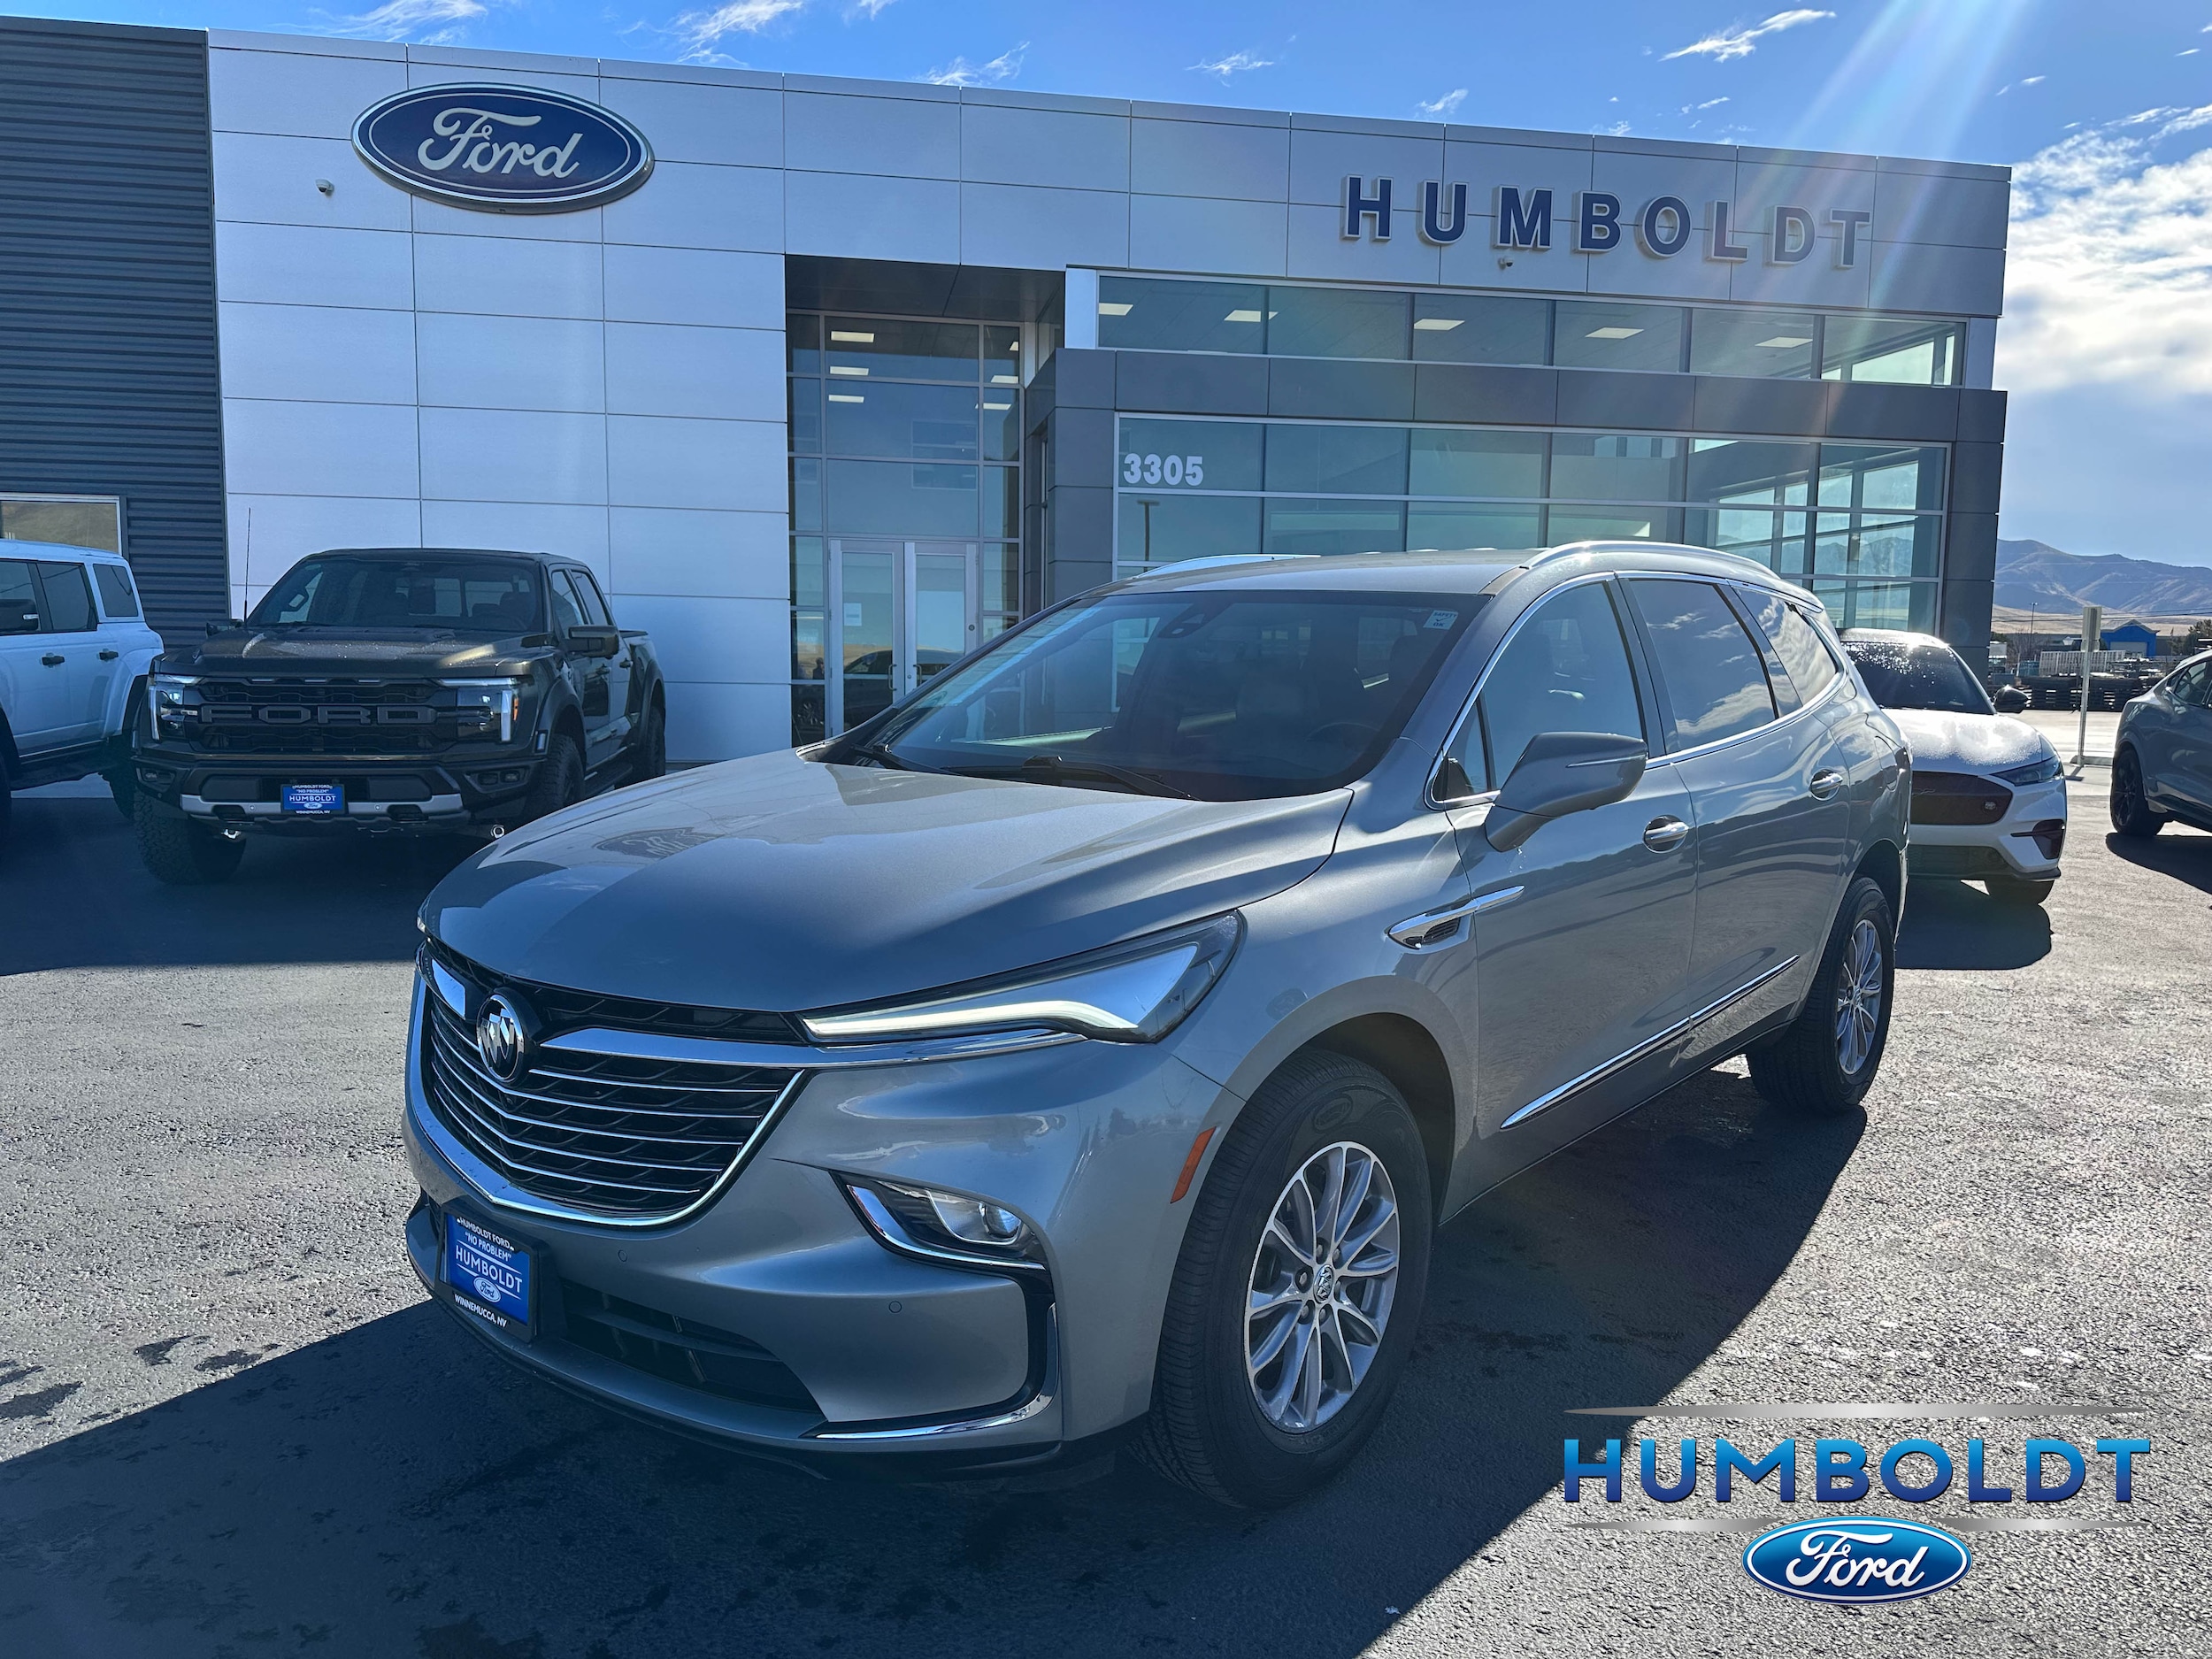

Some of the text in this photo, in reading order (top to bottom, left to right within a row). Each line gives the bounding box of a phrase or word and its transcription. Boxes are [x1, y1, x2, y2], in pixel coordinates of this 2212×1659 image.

[418, 107, 583, 179] Ford
[1341, 173, 1872, 269] HUMBOLDT
[1123, 452, 1204, 487] 3305
[201, 704, 438, 725] FORD
[459, 1217, 511, 1250] HUMBOLDT FORD
[465, 1232, 512, 1263] "NO PROBLEM"
[456, 1244, 523, 1294] HUMBOLDT
[480, 1281, 495, 1298] Ford
[455, 1294, 508, 1328] WINNEMUCCA, NV
